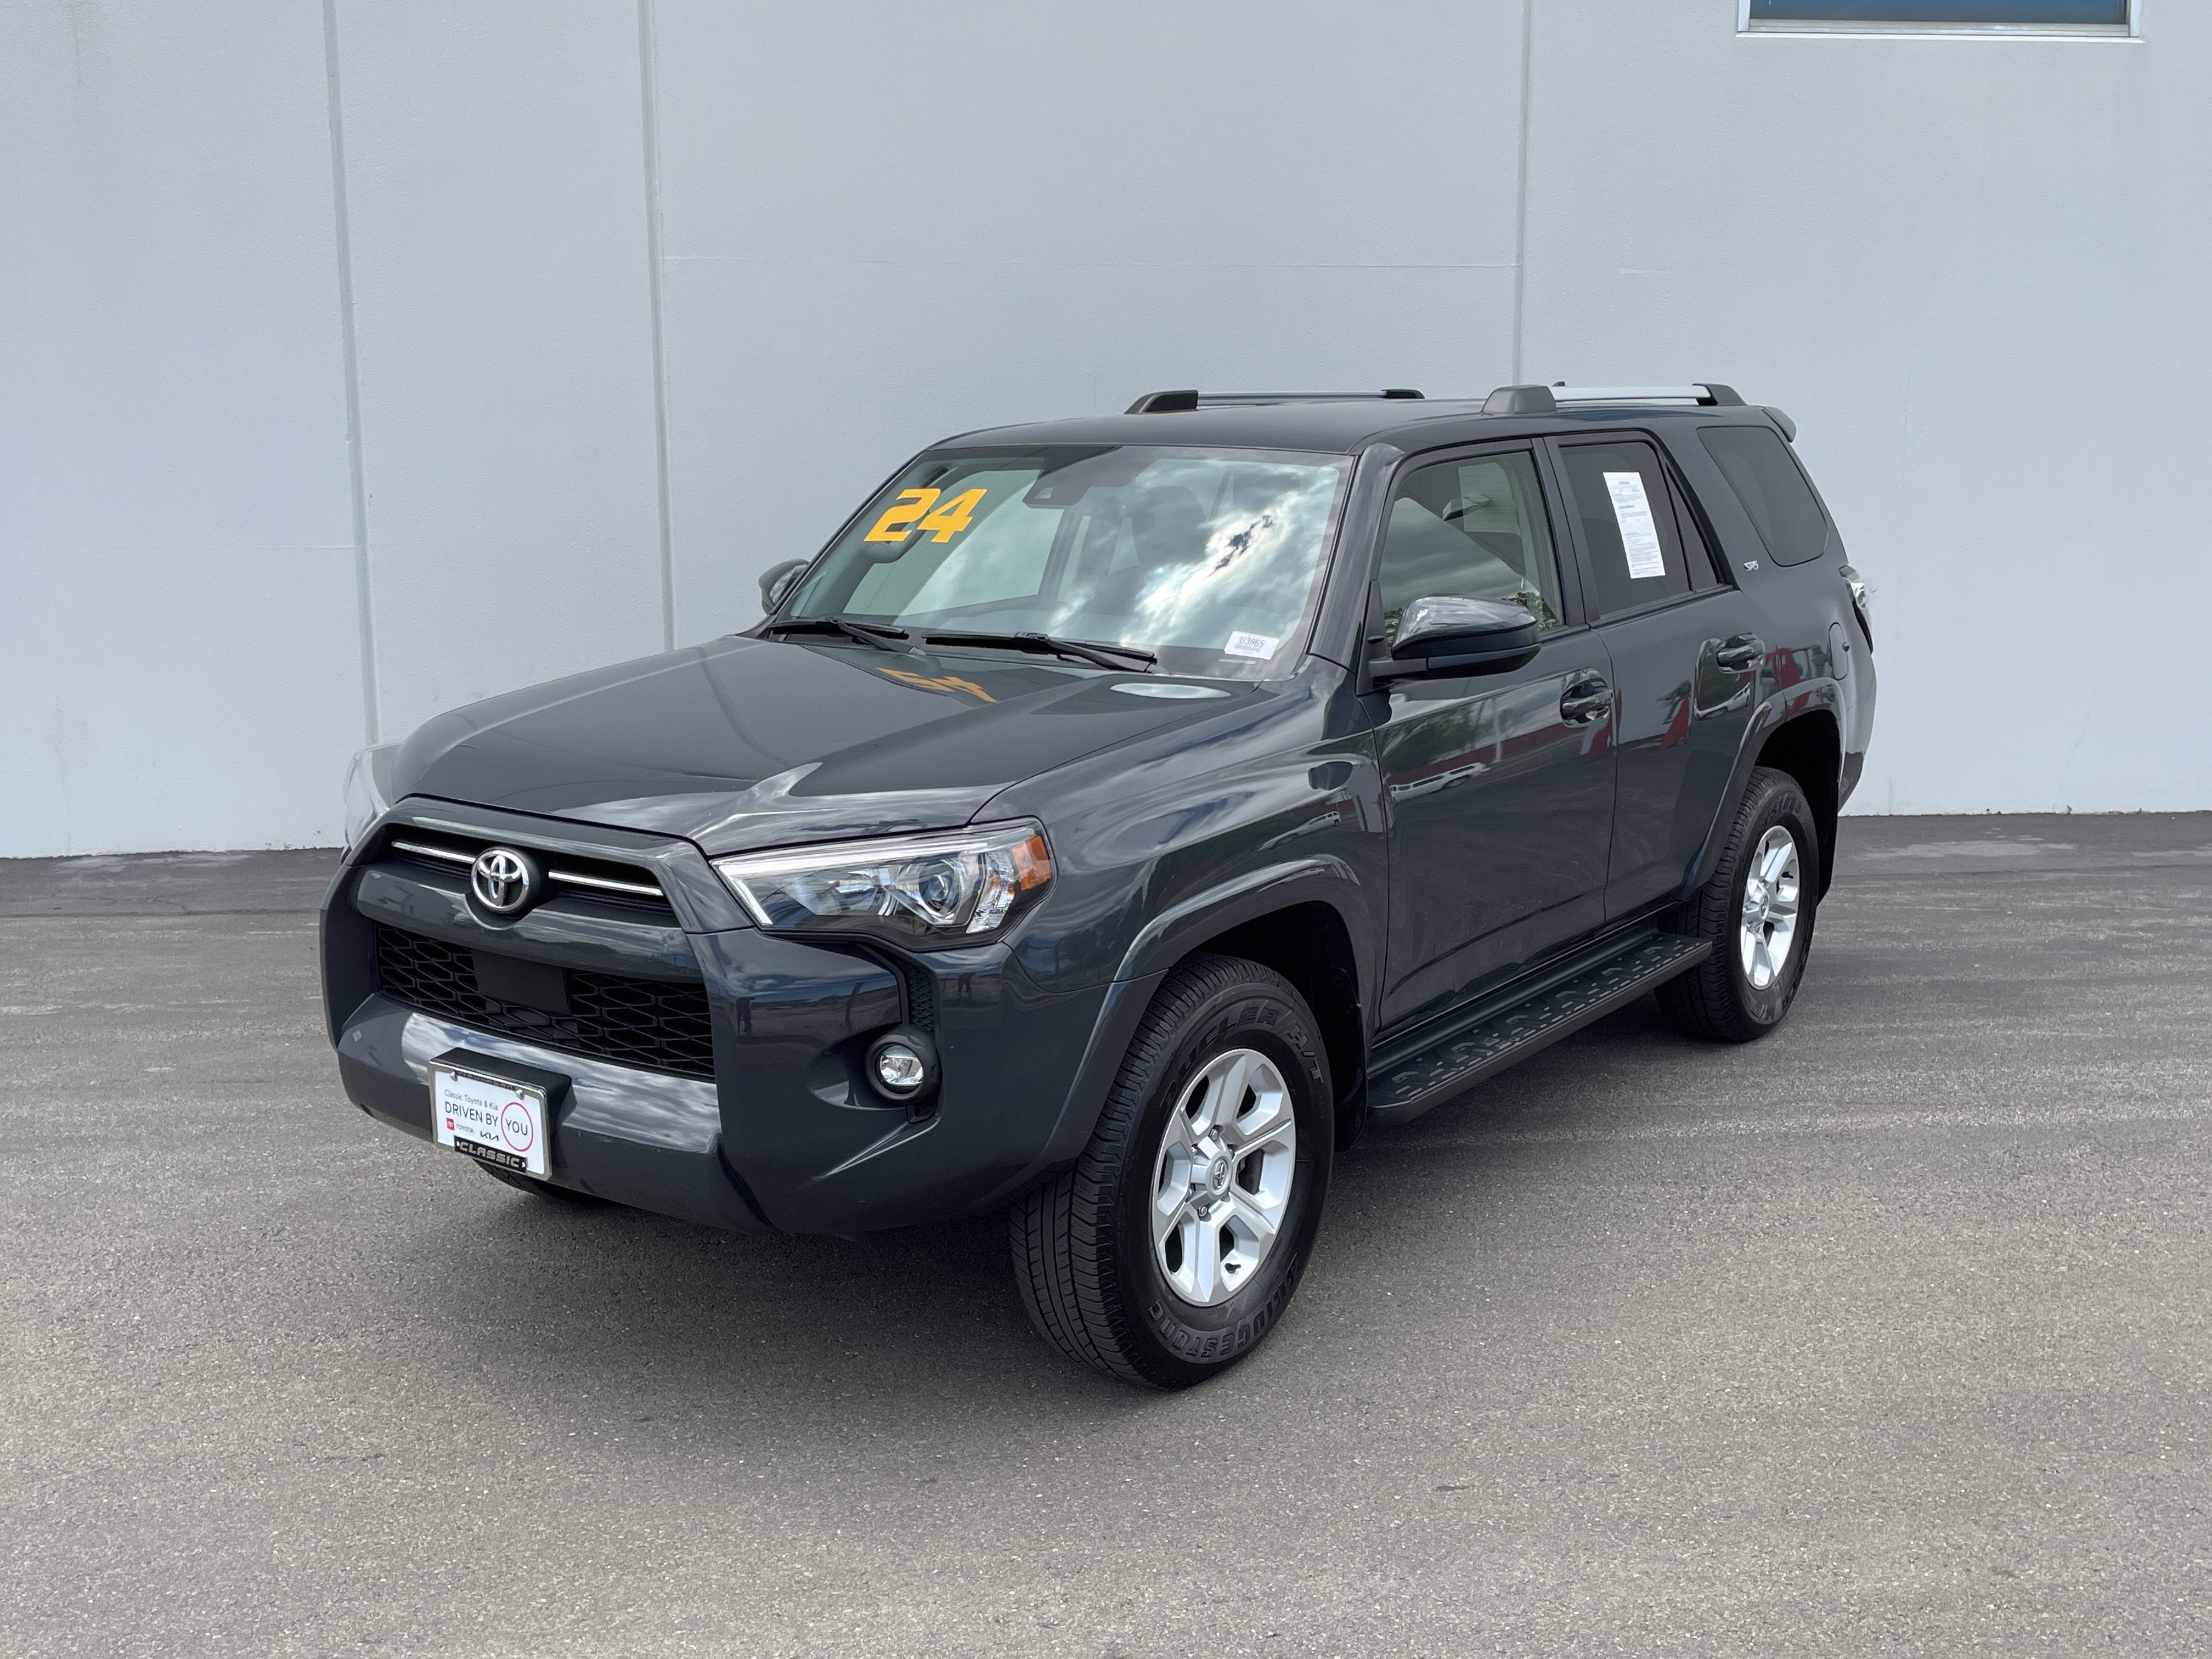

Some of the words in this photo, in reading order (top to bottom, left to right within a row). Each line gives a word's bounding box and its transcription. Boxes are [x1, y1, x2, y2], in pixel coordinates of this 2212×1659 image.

[864, 488, 988, 543] 24
[1239, 636, 1266, 648] U3965
[444, 1089, 462, 1101] Classic
[464, 1094, 482, 1106] Toyota
[489, 1102, 499, 1111] Kia
[445, 1101, 483, 1123] DRIVEN
[486, 1113, 499, 1127] BY
[505, 1118, 528, 1136] YOU
[456, 1123, 474, 1133] TOYOTA
[460, 1141, 520, 1168] CLASSIC
